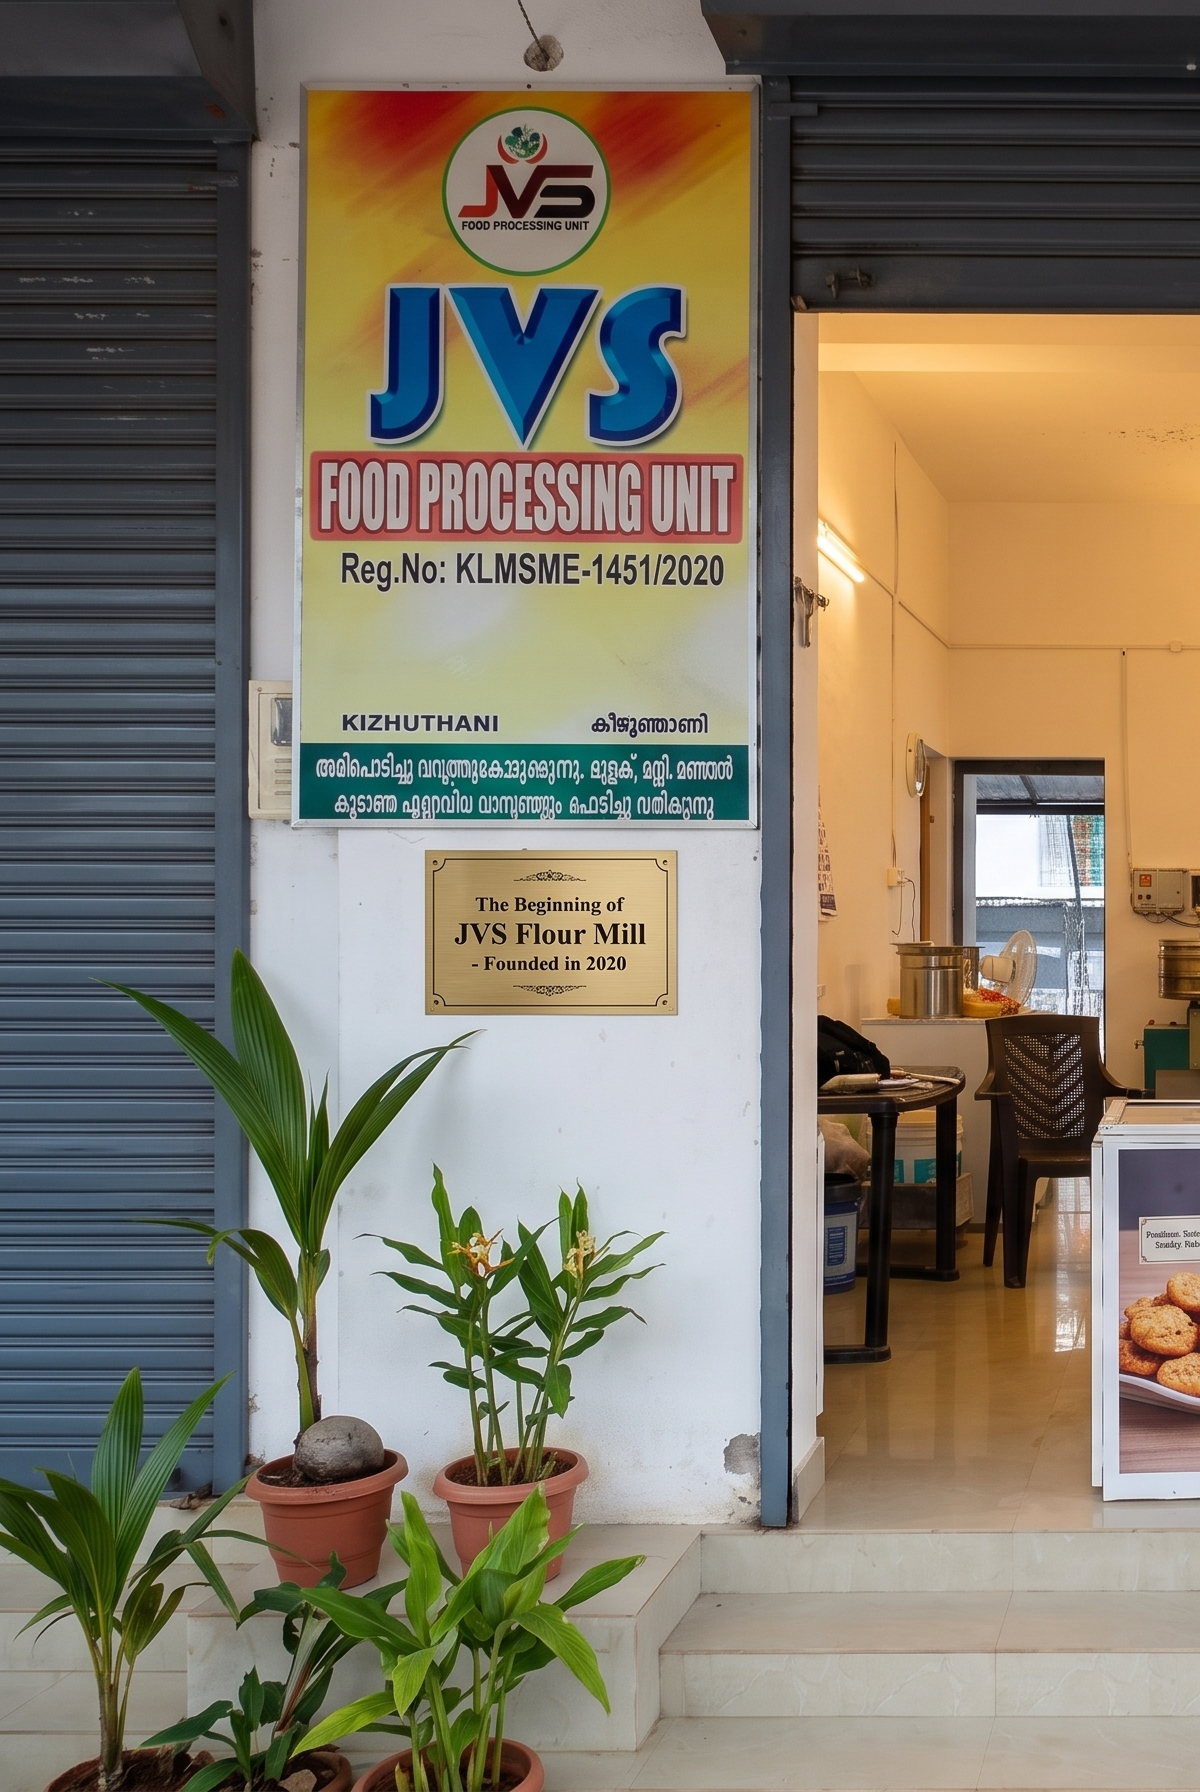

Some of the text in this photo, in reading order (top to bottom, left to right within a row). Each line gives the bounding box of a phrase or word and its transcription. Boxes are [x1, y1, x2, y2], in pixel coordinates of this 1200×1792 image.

[458, 165, 596, 218] JVS
[461, 221, 589, 231] FOOD PROCESSING UNIT
[368, 285, 685, 448] JVS
[319, 461, 734, 533] FOOD PROCESSING UNIT
[341, 552, 724, 592] Reg.No: KLMSME-1451/2020
[341, 714, 498, 732] KIZHUTHANI
[475, 897, 625, 915] The Beginning of
[455, 923, 646, 945] JVS Flour Mill
[483, 956, 559, 970] Founded
[565, 956, 580, 970] in
[586, 956, 626, 970] 2020
